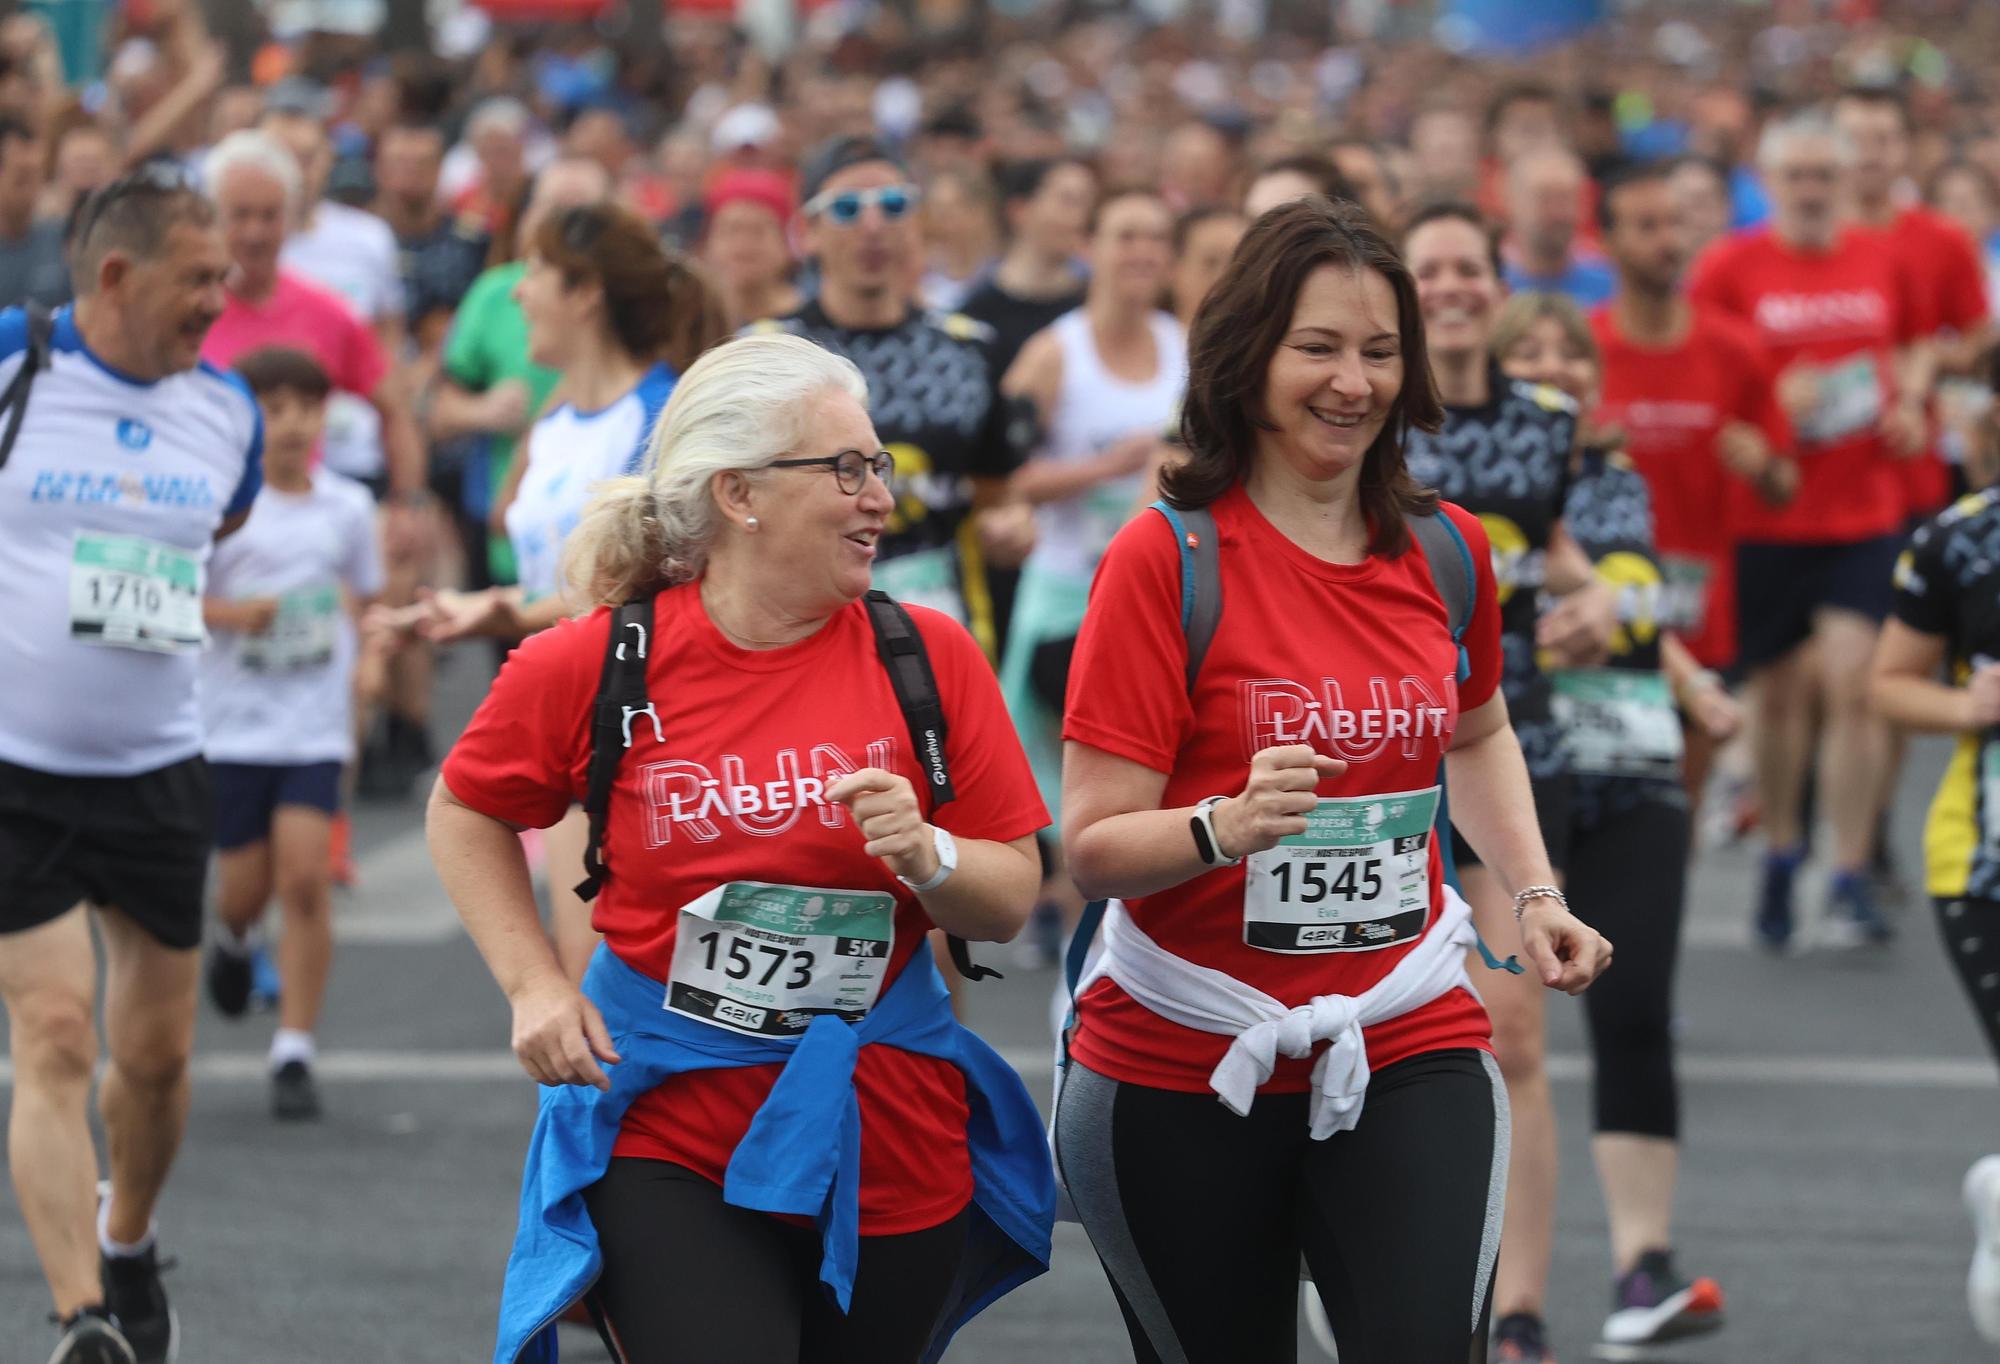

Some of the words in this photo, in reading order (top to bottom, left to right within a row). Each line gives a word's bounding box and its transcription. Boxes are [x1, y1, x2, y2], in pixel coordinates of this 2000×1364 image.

[88, 574, 161, 615] 1710
[1236, 673, 1459, 764] RUN
[924, 729, 947, 786] Quechua
[639, 737, 899, 850] RUN
[670, 777, 826, 822] LÃBER
[1308, 818, 1354, 828] PRESAS
[1400, 835, 1422, 853] 5K
[1270, 858, 1382, 904] 1545
[1318, 906, 1340, 918] Eva
[1302, 929, 1342, 942] 42K
[847, 939, 877, 957] 5K
[698, 931, 816, 990] 1573
[855, 960, 865, 971] F
[725, 982, 776, 1003] Amparo
[720, 1005, 760, 1028] 42K
